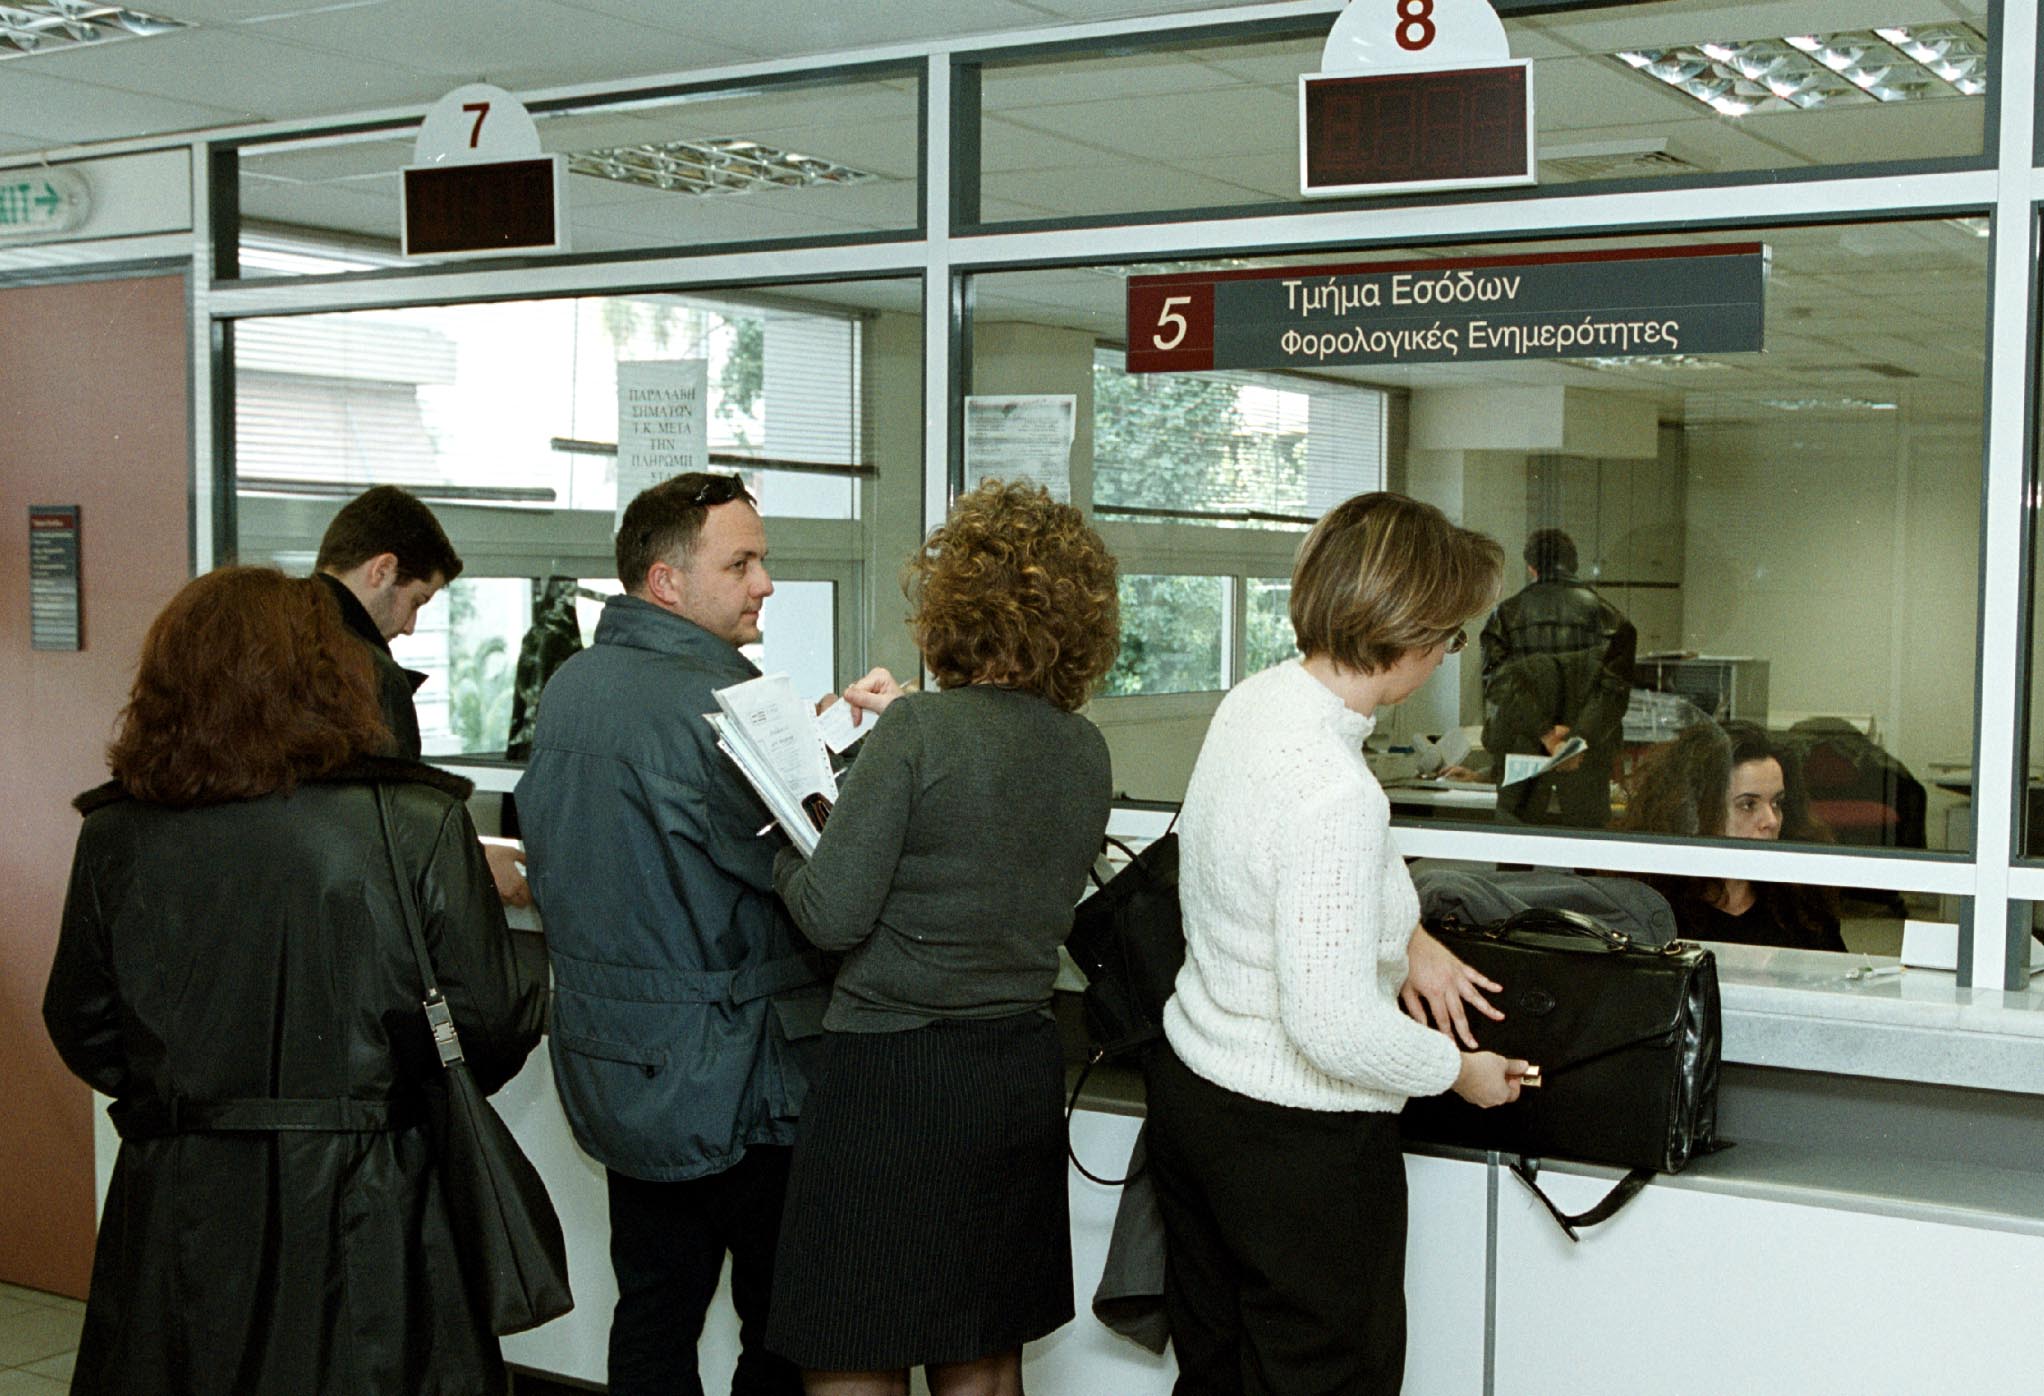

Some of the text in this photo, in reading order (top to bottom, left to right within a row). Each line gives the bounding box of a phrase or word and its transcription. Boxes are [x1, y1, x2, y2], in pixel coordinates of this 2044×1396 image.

[1395, 0, 1436, 51] 8
[463, 102, 490, 148] 7
[1282, 270, 1521, 317] Τμήμα Εσόδων
[1153, 296, 1192, 350] 5
[1280, 315, 1679, 361] Φορολογικές Ενημερότητες
[629, 387, 696, 401] ΠΑΡΑΛΑΒΗ
[650, 439, 675, 451] ΤΗΝ
[657, 422, 692, 434] ΜΕΤΑ
[632, 454, 693, 467] ΠΛΗΡΩΜΗ
